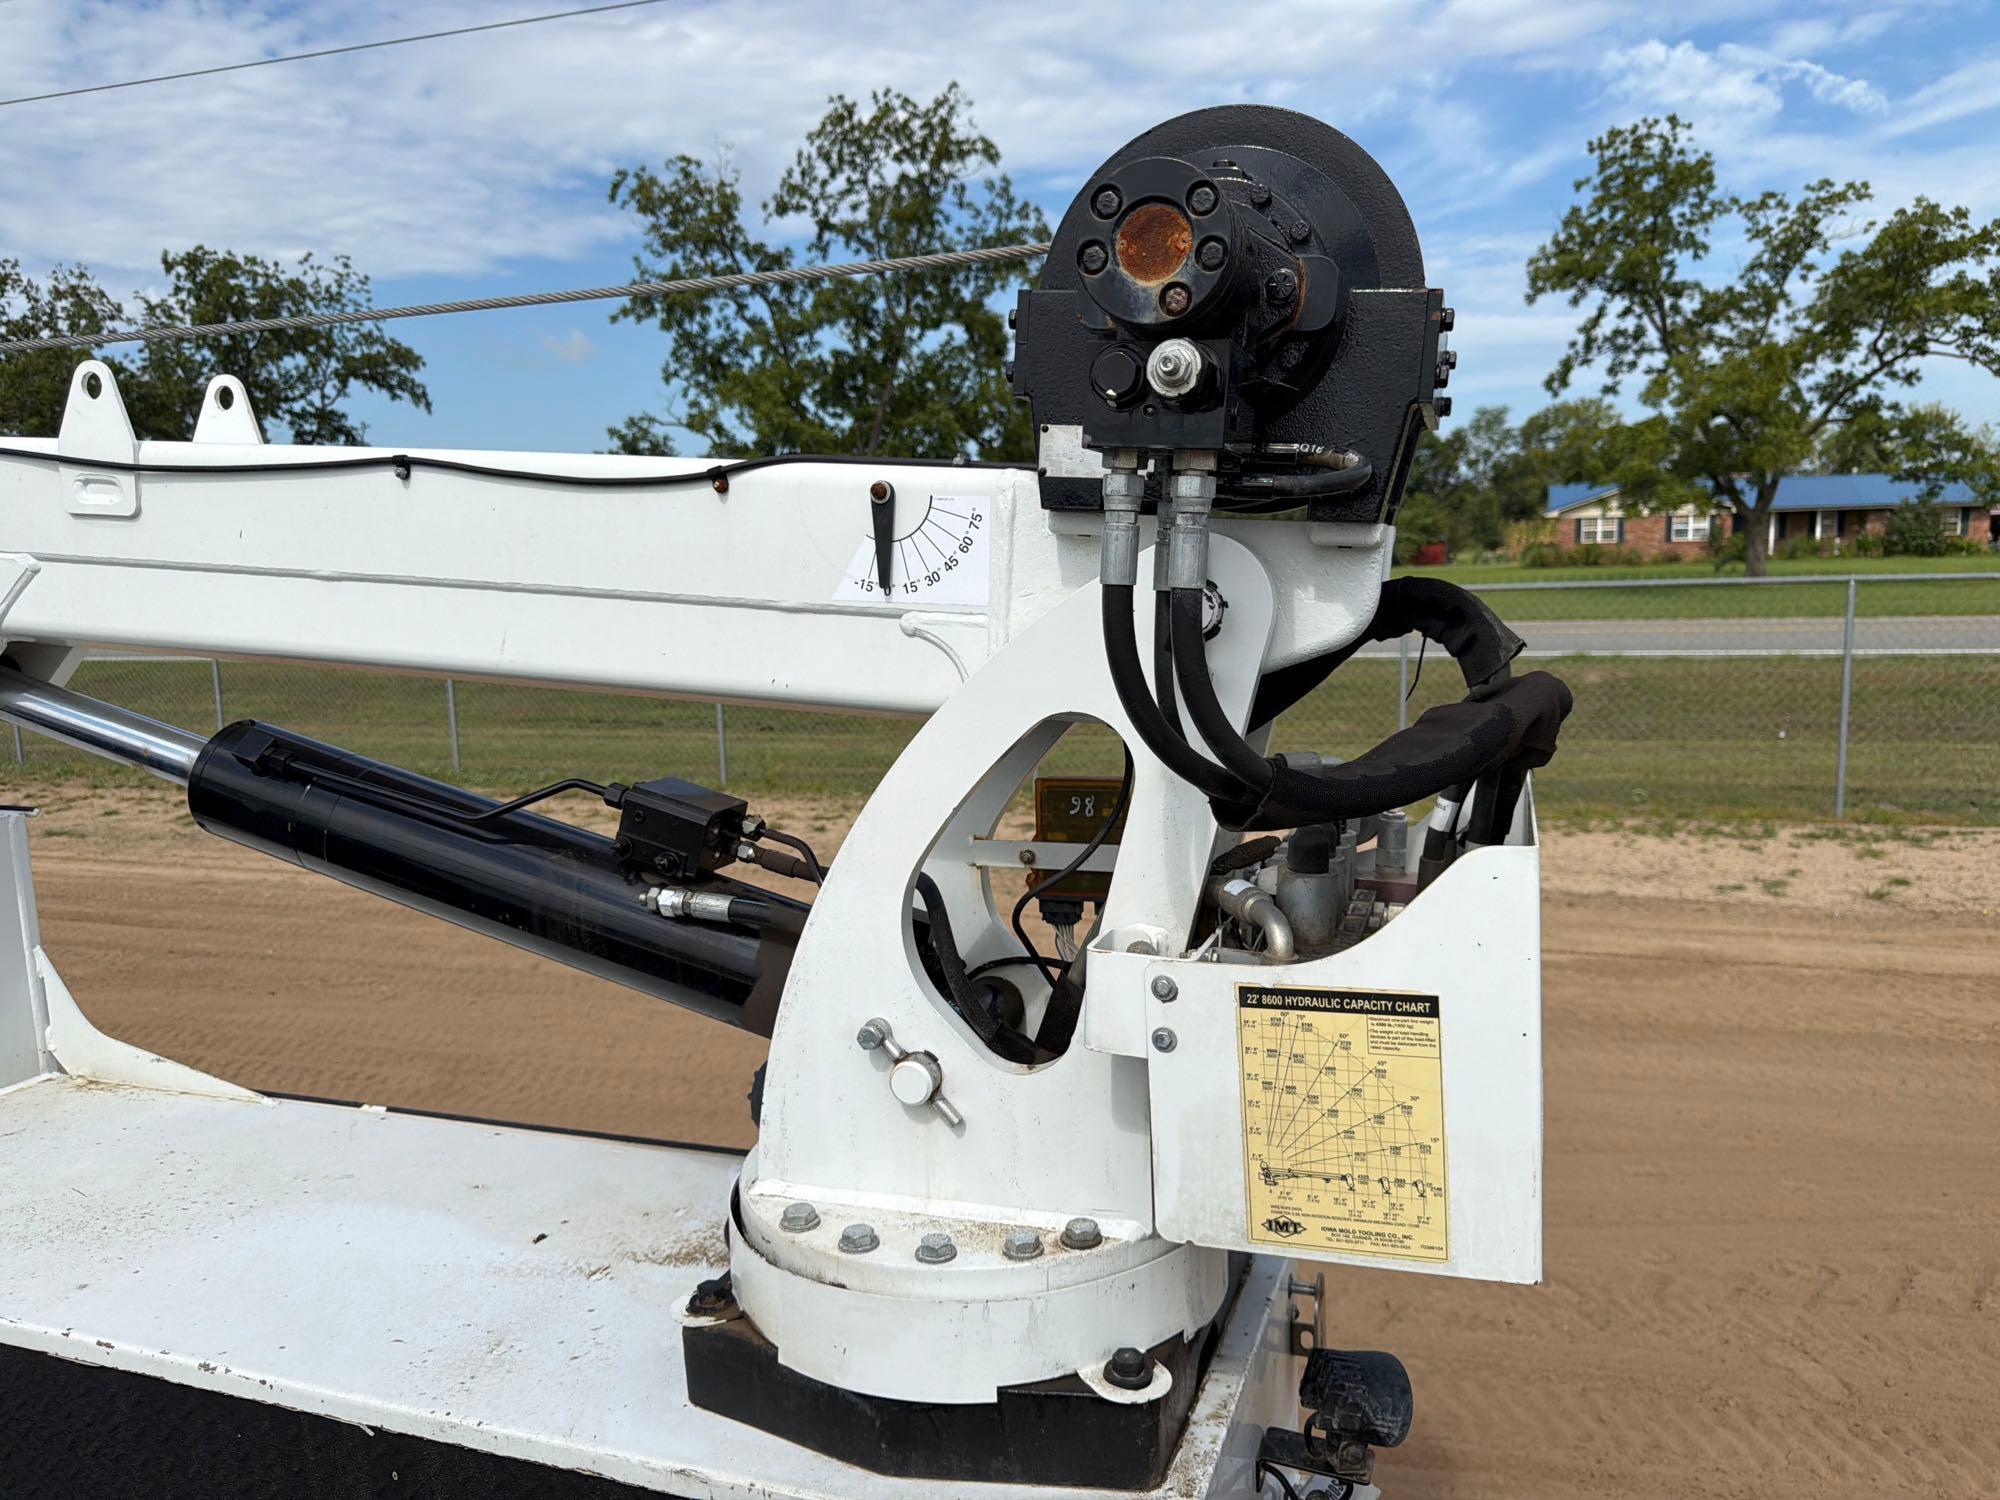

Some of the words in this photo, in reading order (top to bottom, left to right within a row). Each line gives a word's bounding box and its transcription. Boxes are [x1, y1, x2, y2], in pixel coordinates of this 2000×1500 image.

[958, 530, 974, 554] 60°
[944, 551, 959, 572] 45°
[924, 567, 941, 586] 30°
[1246, 994, 1260, 1004] 22'
[1262, 994, 1282, 1005] 8600
[1285, 996, 1340, 1008] HYDRAULIC
[1344, 999, 1392, 1011] CAPACITY
[1396, 1002, 1430, 1013] CHART
[1266, 1219, 1302, 1233] IMT
